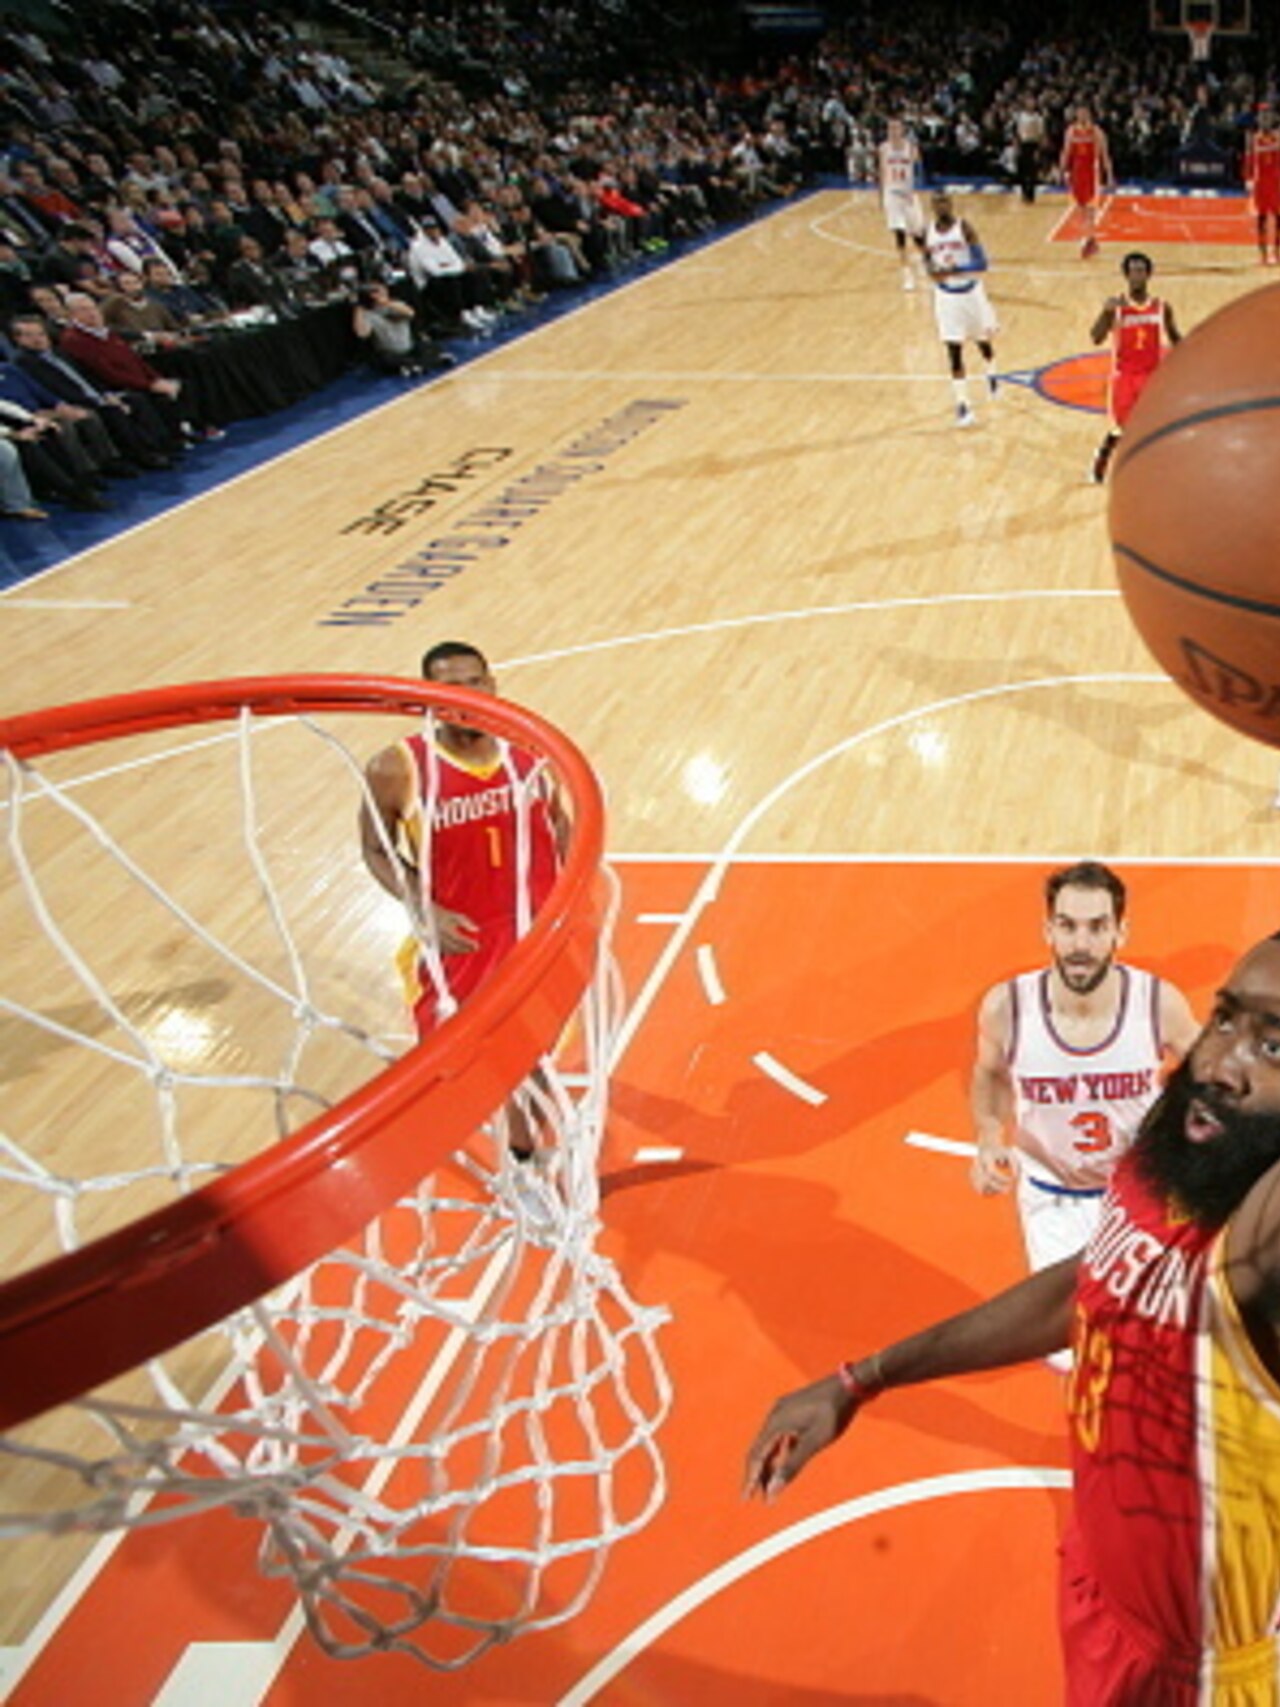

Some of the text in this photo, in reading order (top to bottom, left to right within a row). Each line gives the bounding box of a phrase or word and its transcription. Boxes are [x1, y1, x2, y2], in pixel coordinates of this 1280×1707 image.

[339, 447, 513, 536] CHASE
[317, 535, 510, 626] GARDEN
[485, 826, 501, 868] 1
[1020, 1069, 1153, 1104] NEW YORK
[1069, 1112, 1113, 1153] 3
